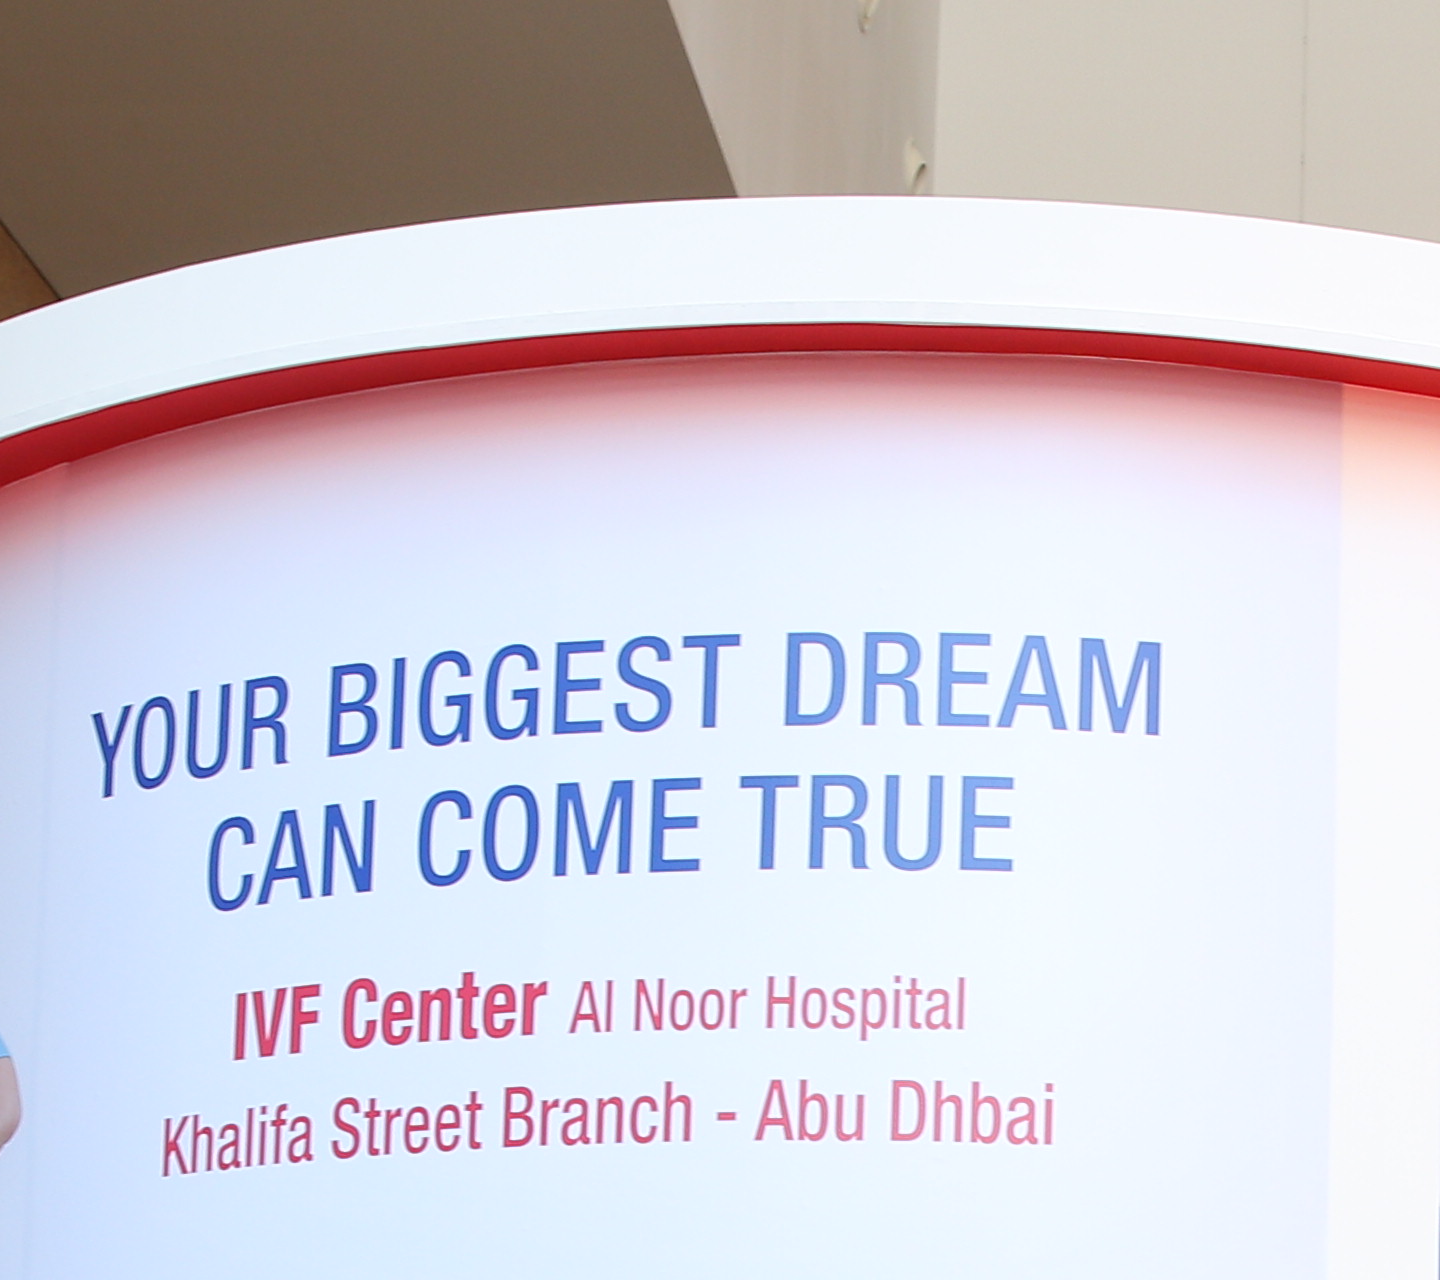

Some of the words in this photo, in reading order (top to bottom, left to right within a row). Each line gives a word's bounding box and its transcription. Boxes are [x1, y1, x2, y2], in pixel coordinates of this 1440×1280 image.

[90, 675, 290, 799] YOUR
[327, 634, 741, 757] BIGGEST
[784, 631, 1162, 736] DREAM
[207, 799, 377, 912] CAN
[417, 777, 702, 887] COME
[739, 774, 1015, 872] TRUE
[232, 983, 322, 1061] IVF
[341, 970, 548, 1049] Center
[568, 979, 614, 1034] Al
[633, 977, 748, 1032] Noor
[764, 975, 966, 1041] Hospital
[161, 1103, 313, 1178] Khalifa
[331, 1090, 484, 1160] Street
[502, 1081, 692, 1148] Branch
[716, 1111, 737, 1121] -
[754, 1079, 865, 1141] Abu
[890, 1079, 1054, 1145] Dhbai
